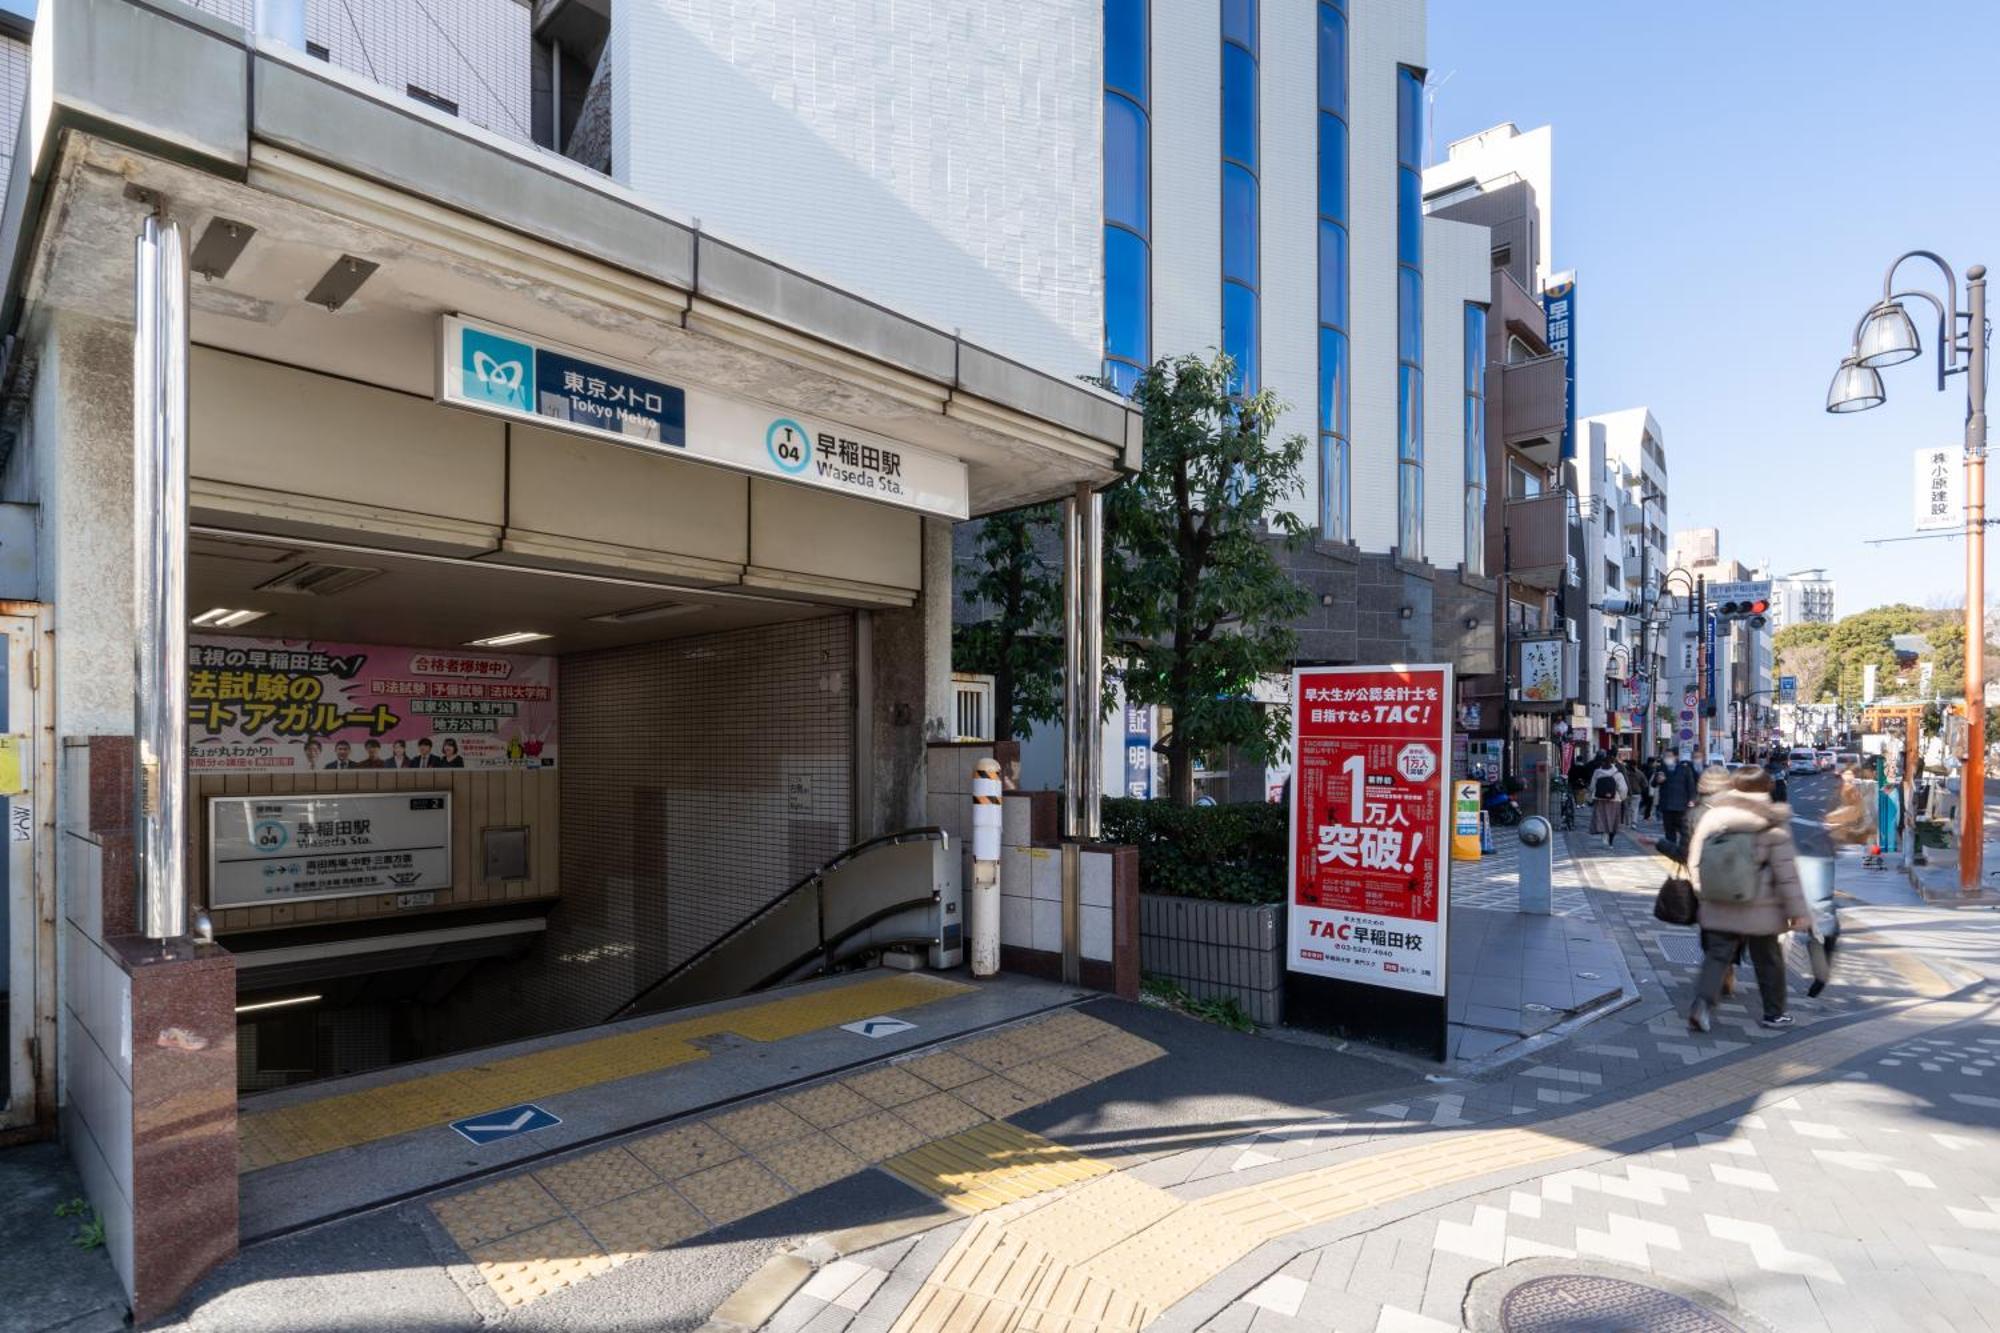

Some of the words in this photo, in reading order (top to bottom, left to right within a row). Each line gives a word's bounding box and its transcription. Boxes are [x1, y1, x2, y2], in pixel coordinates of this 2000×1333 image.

[563, 370, 662, 414] 東京メトロ
[569, 396, 613, 419] Tokyo
[616, 403, 659, 430] Metro
[784, 429, 793, 443] T
[777, 442, 800, 463] 04
[815, 432, 901, 477] 早稲田駅
[816, 460, 875, 489] Waseda
[878, 474, 904, 496] Sta.
[1304, 686, 1438, 702] 早大生が公認会計士を
[259, 835, 278, 846] 04
[297, 819, 371, 838] 早稲田駅
[1317, 824, 1423, 873] 突破!
